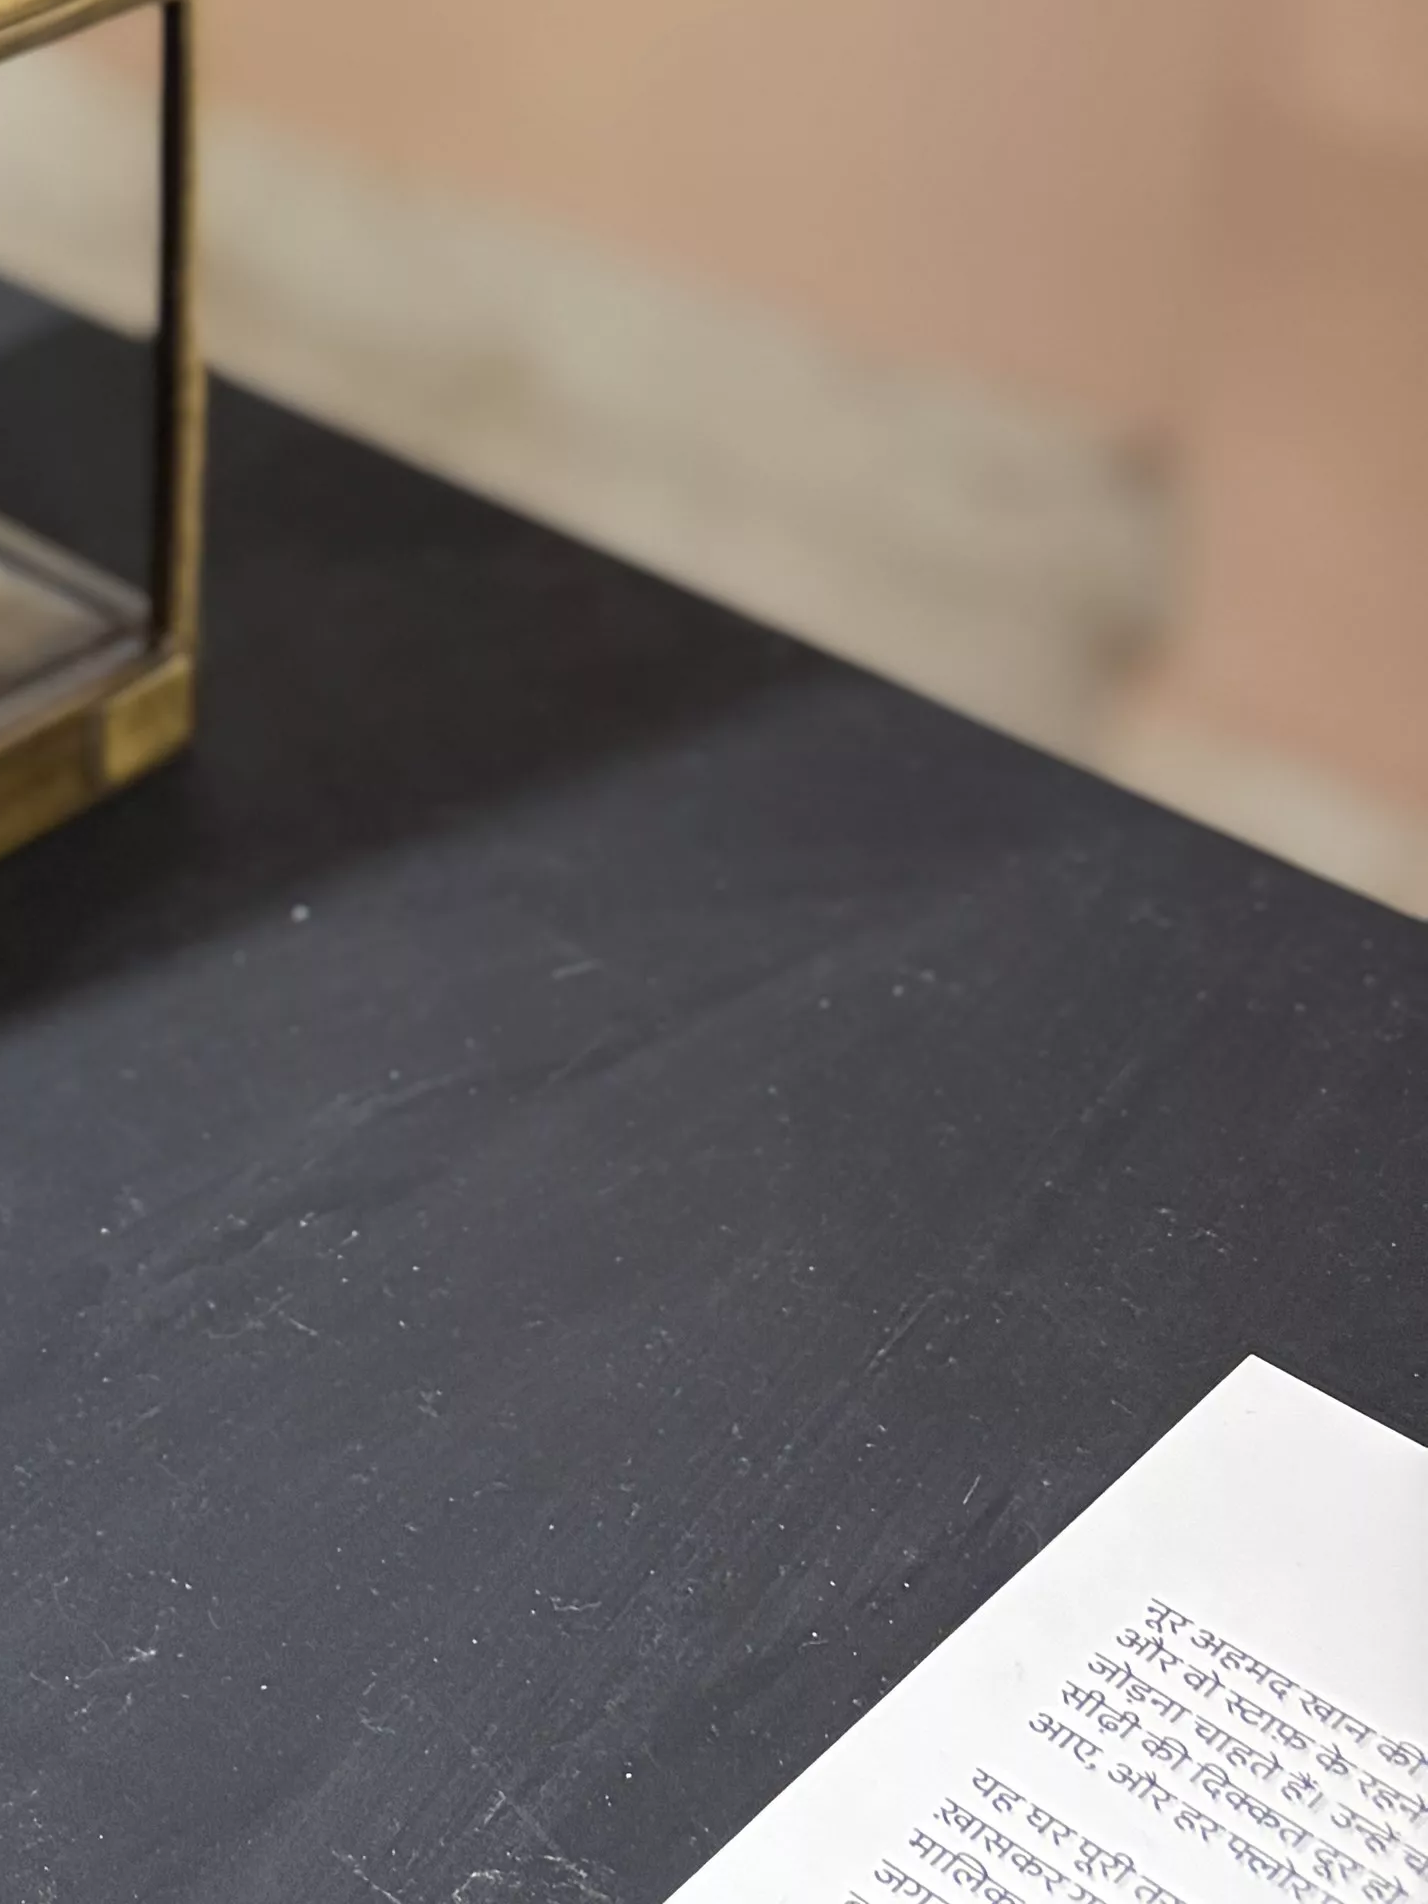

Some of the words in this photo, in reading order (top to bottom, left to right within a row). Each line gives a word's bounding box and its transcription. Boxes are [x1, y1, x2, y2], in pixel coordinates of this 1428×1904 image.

[1116, 1628, 1184, 1673] और
[1183, 1664, 1226, 1698] वो
[1225, 1689, 1316, 1750] स्टाफ़
[1315, 1743, 1358, 1775] के
[1145, 1597, 1195, 1634] नूर
[1190, 1629, 1300, 1700] अहमद
[1299, 1689, 1377, 1743] खान
[972, 1767, 1027, 1813] यह
[1026, 1802, 1078, 1846] घर
[1074, 1835, 1137, 1884] पूरी
[1029, 1712, 1104, 1771] आए,
[1107, 1762, 1178, 1812] और
[1174, 1800, 1226, 1842] हर
[1228, 1831, 1318, 1901] फ्लोर
[1061, 1680, 1142, 1739] सीढ़ी
[1142, 1731, 1192, 1771] की
[1190, 1762, 1315, 1848] दिक्कत
[1313, 1838, 1366, 1880] दूर
[1088, 1652, 1193, 1723] जोड़ना
[1194, 1714, 1284, 1780] चाहते
[1330, 1801, 1401, 1854] उन्हें
[933, 1797, 1072, 1894] ख़ासकर
